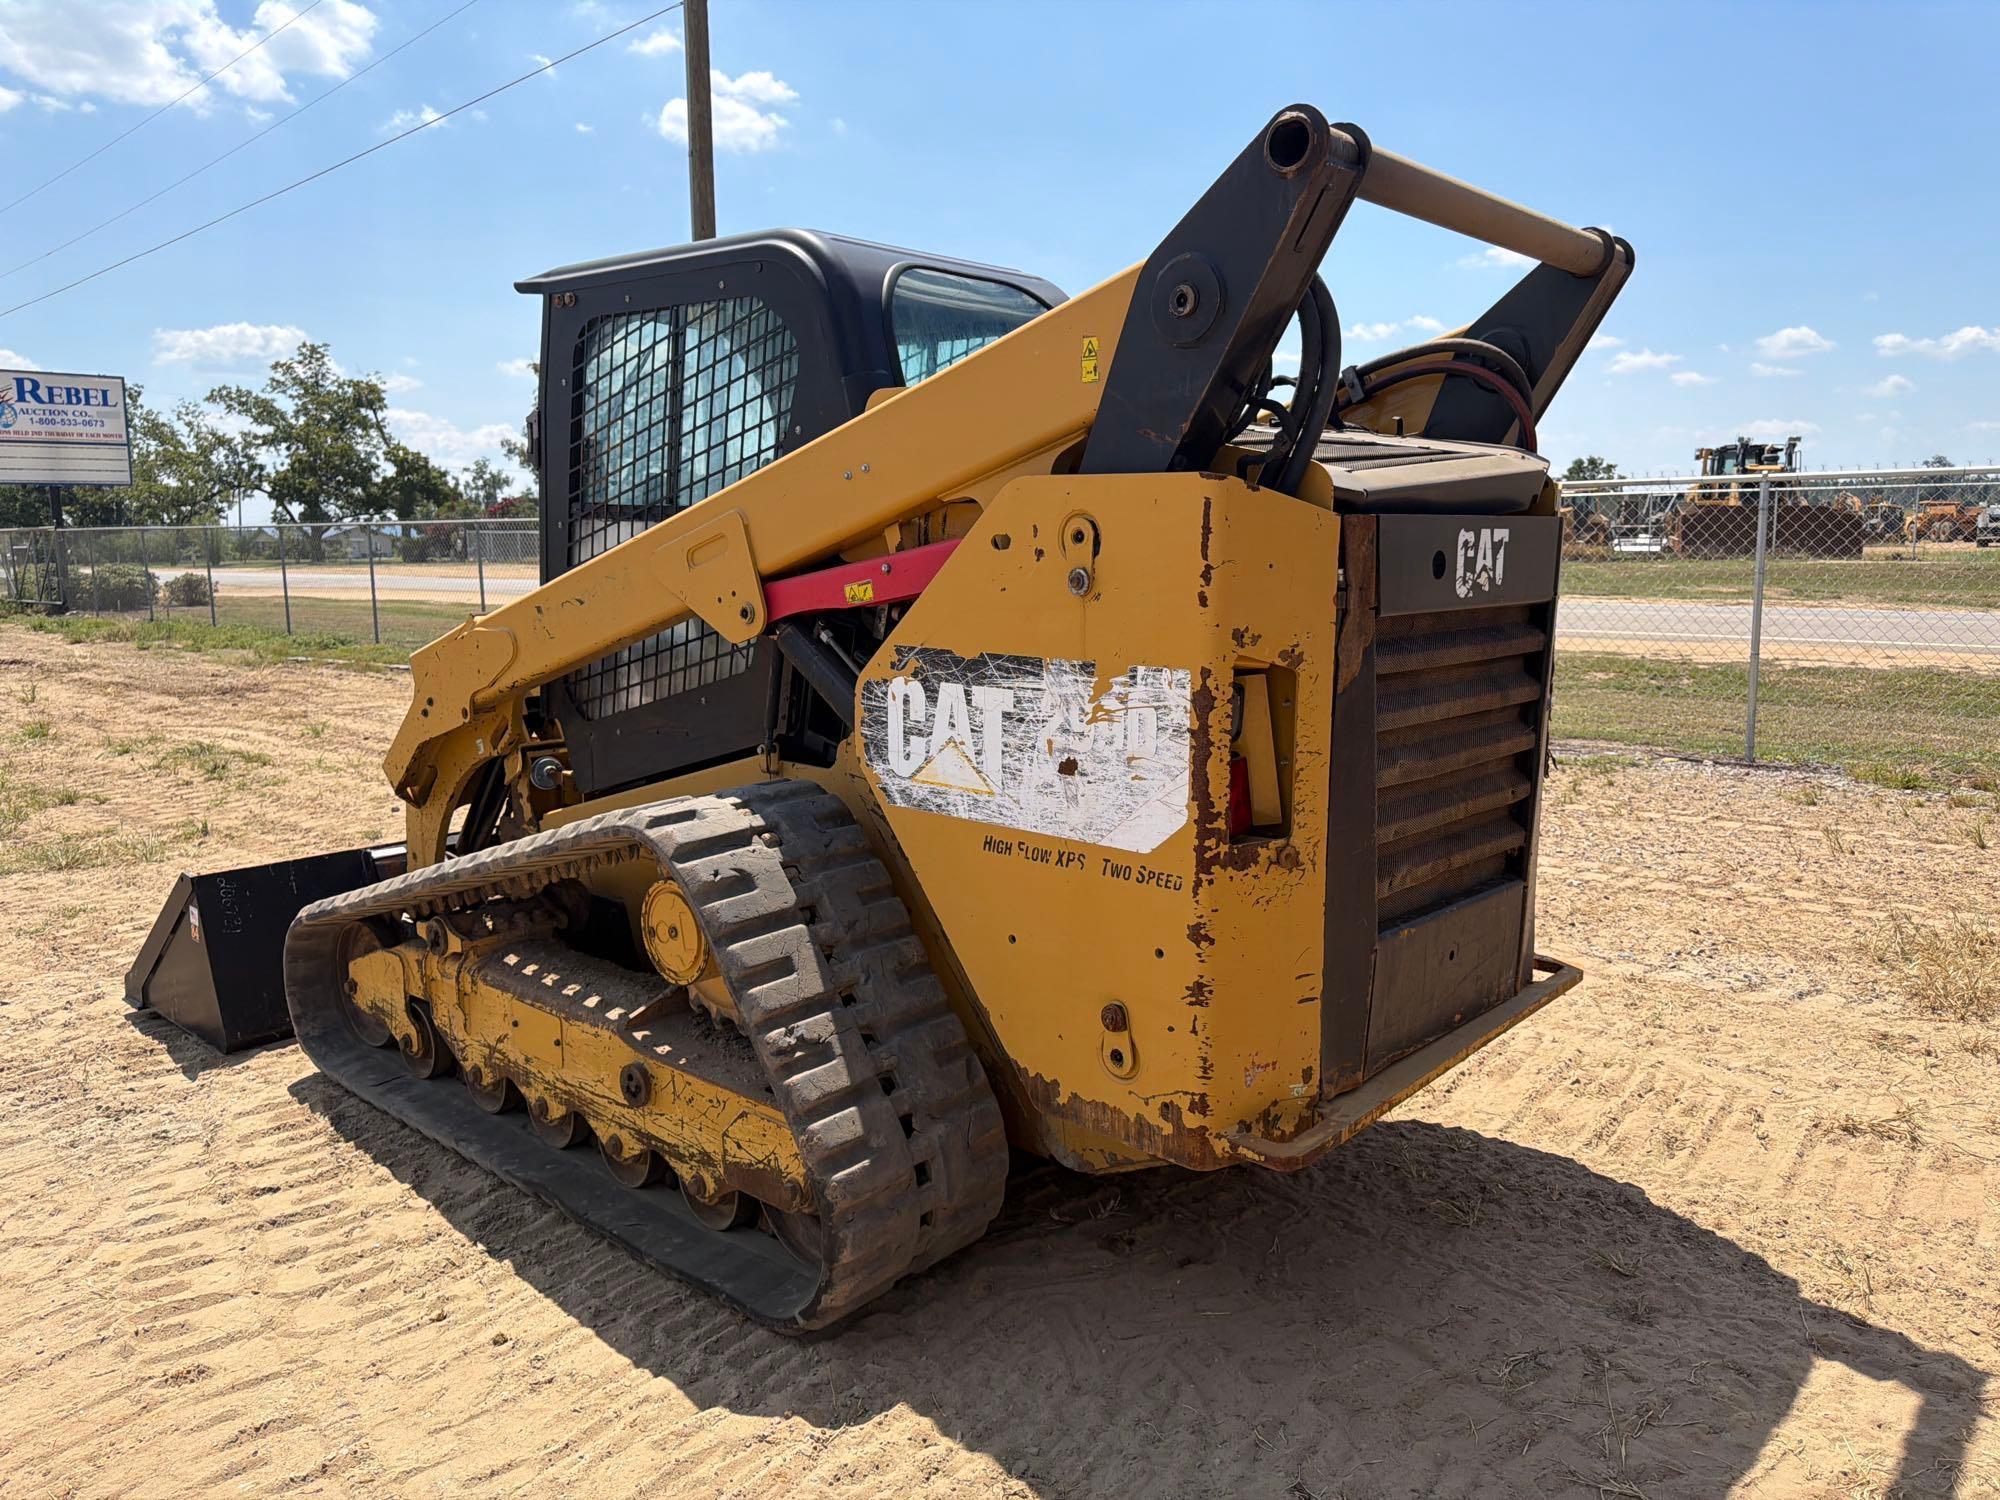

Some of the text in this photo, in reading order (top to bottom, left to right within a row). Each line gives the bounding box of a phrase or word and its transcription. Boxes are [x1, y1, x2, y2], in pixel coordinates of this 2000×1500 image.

[12, 377, 119, 408] REBEL
[18, 407, 92, 418] AUCTION CO.
[29, 417, 105, 428] 1-800-533-0673
[1456, 528, 1509, 598] CAT
[888, 676, 1014, 795] CAT
[983, 835, 1012, 856] HIGH
[1055, 849, 1086, 870] XPS
[1102, 858, 1132, 881] TWO
[1135, 865, 1183, 891] SPEED
